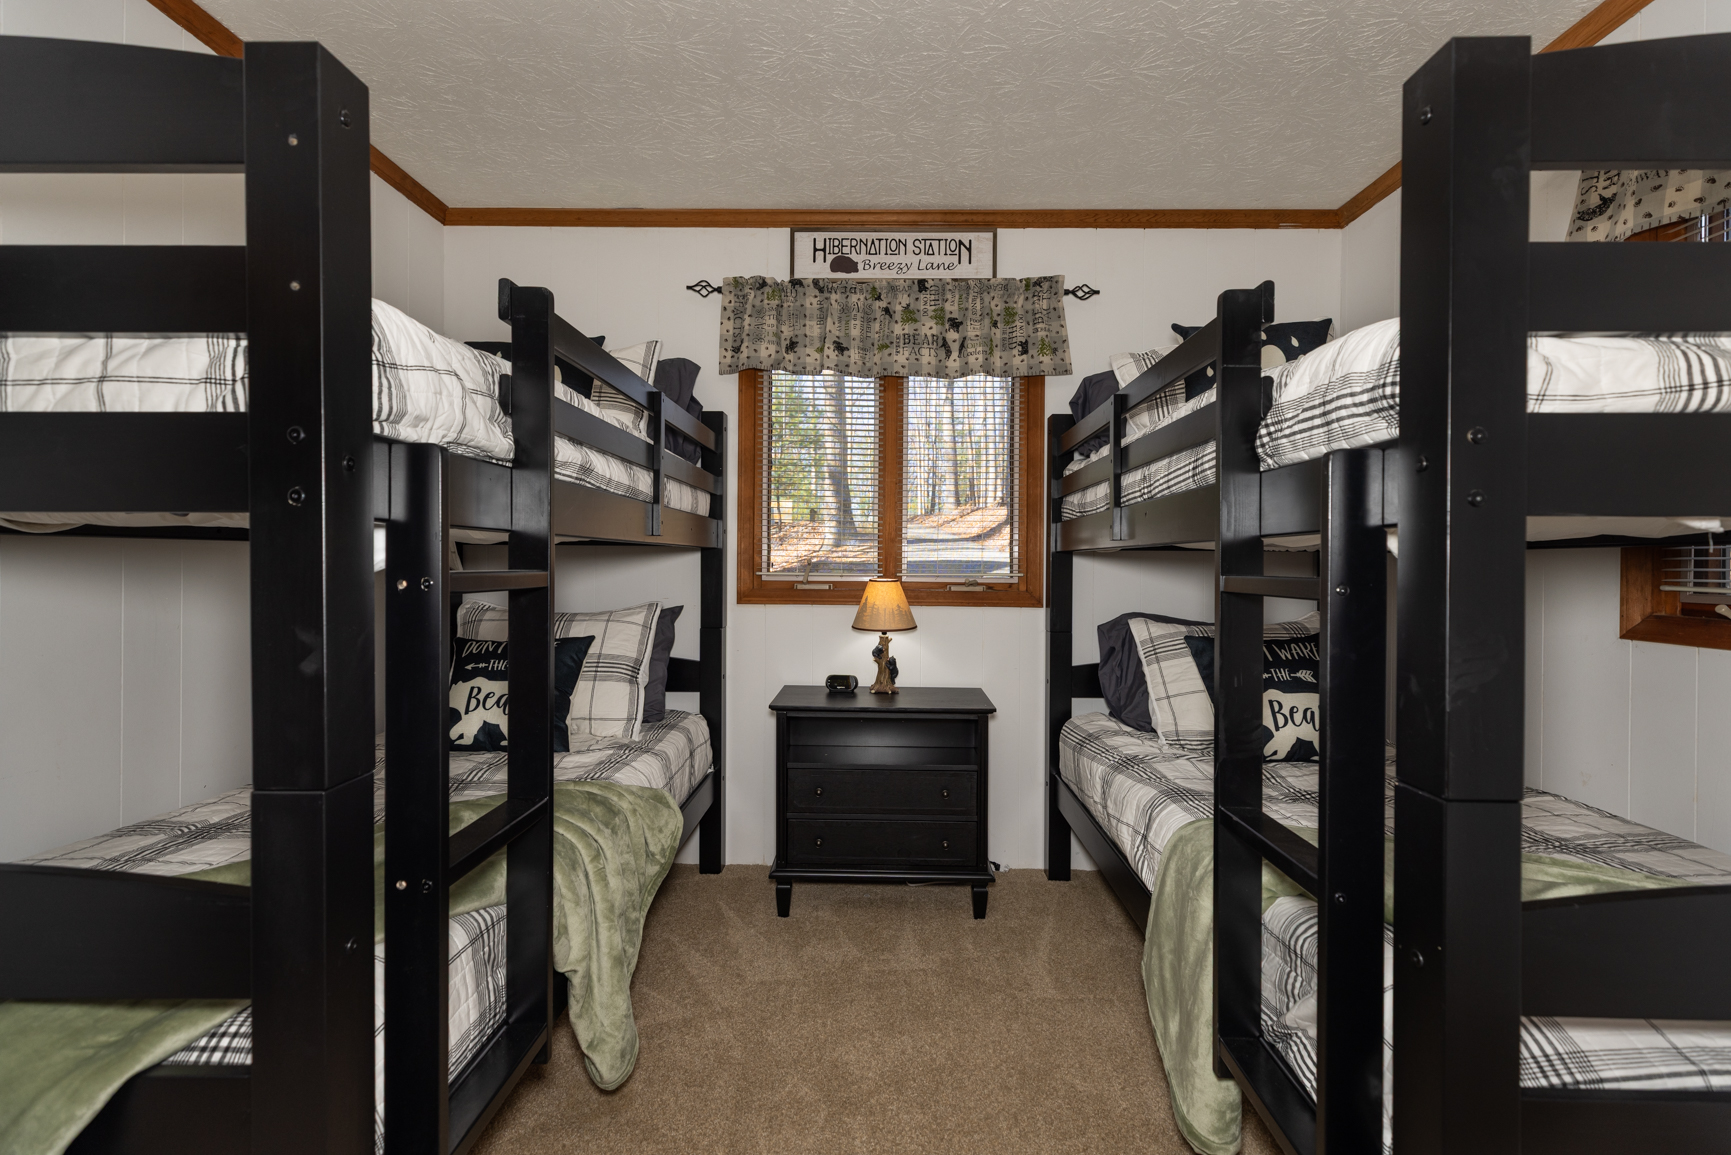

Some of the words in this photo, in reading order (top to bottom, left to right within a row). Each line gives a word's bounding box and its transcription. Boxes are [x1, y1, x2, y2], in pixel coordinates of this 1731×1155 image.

[813, 237, 907, 263] HIBERNATION
[912, 238, 972, 264] STATION
[861, 259, 913, 274] Breezy
[917, 258, 959, 271] Lane
[902, 332, 939, 346] BEAR
[902, 346, 939, 358] FACTS
[488, 659, 508, 671] THE
[1269, 668, 1292, 682] THE
[464, 686, 509, 715] Bea
[1268, 699, 1320, 732] Bea
